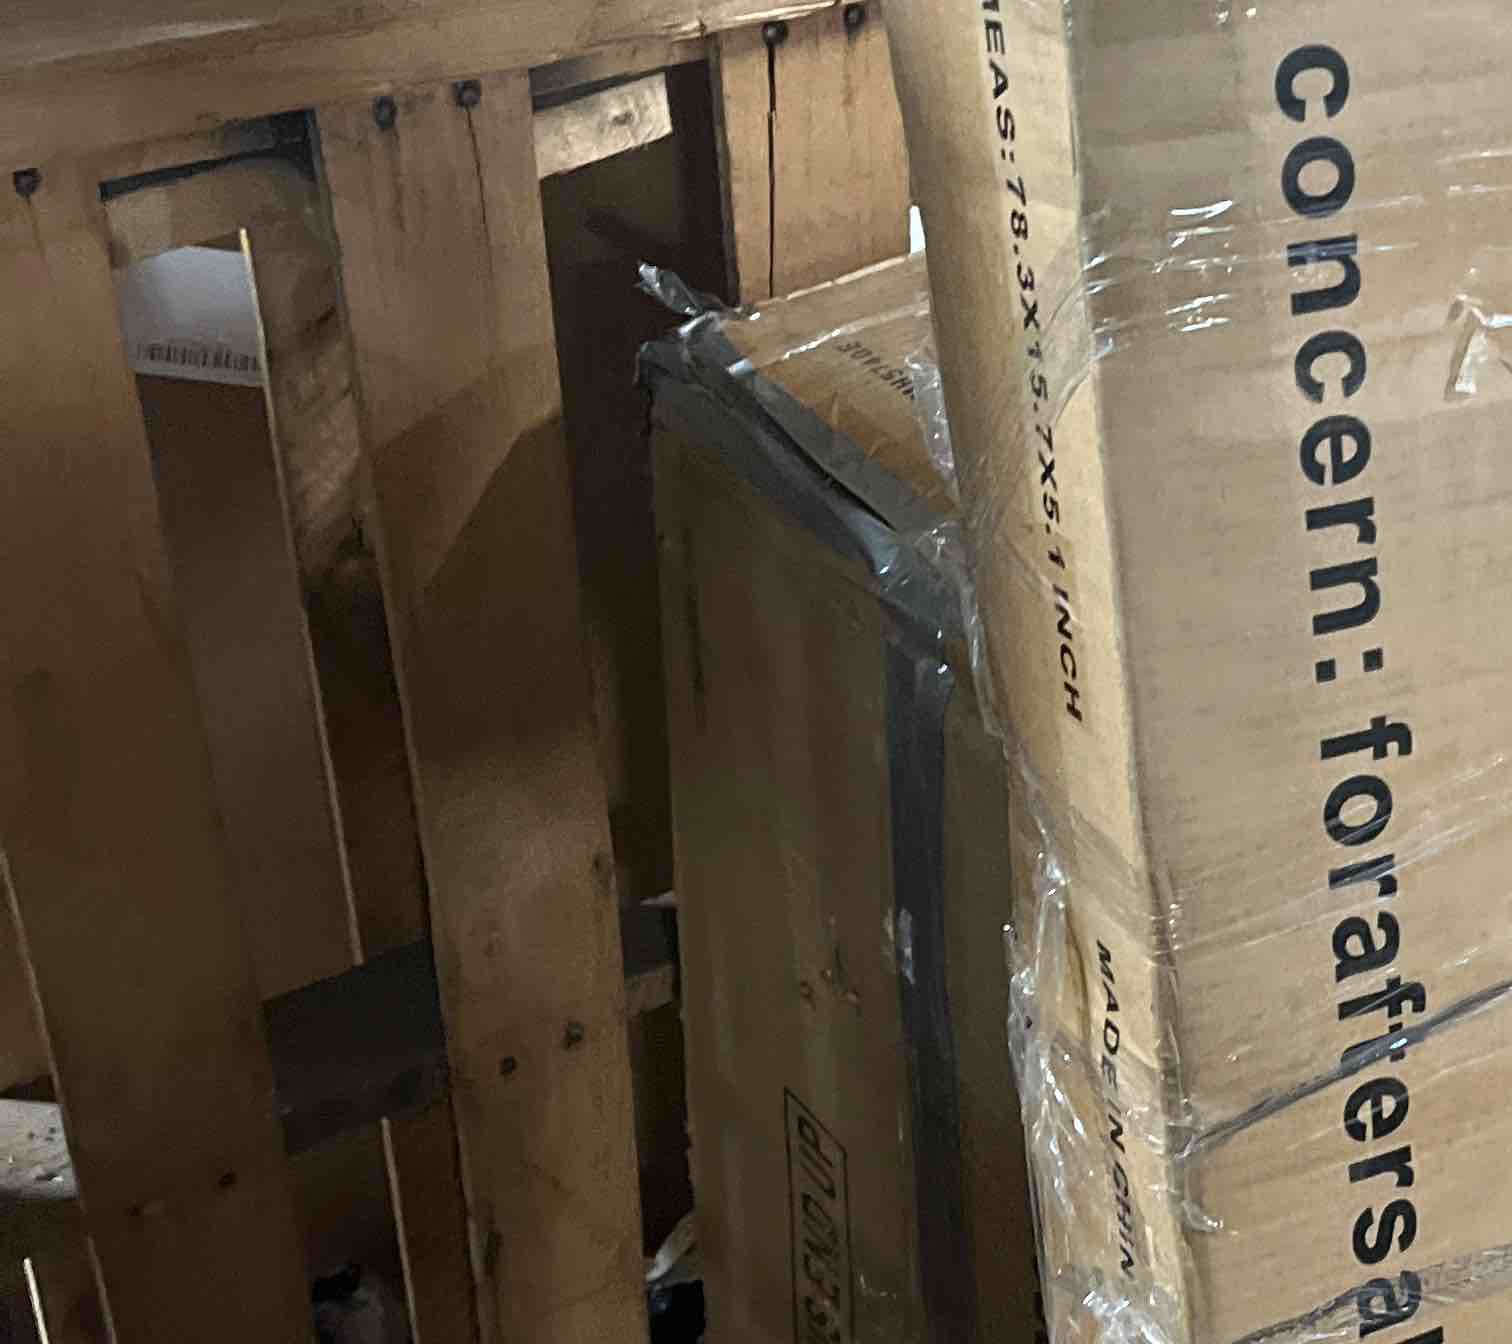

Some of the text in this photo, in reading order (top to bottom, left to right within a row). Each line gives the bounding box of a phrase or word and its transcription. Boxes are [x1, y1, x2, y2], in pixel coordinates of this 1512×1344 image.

[1275, 44, 1383, 685] concern:
[1052, 583, 1083, 722] INCH
[1113, 1160, 1136, 1280] CHIN
